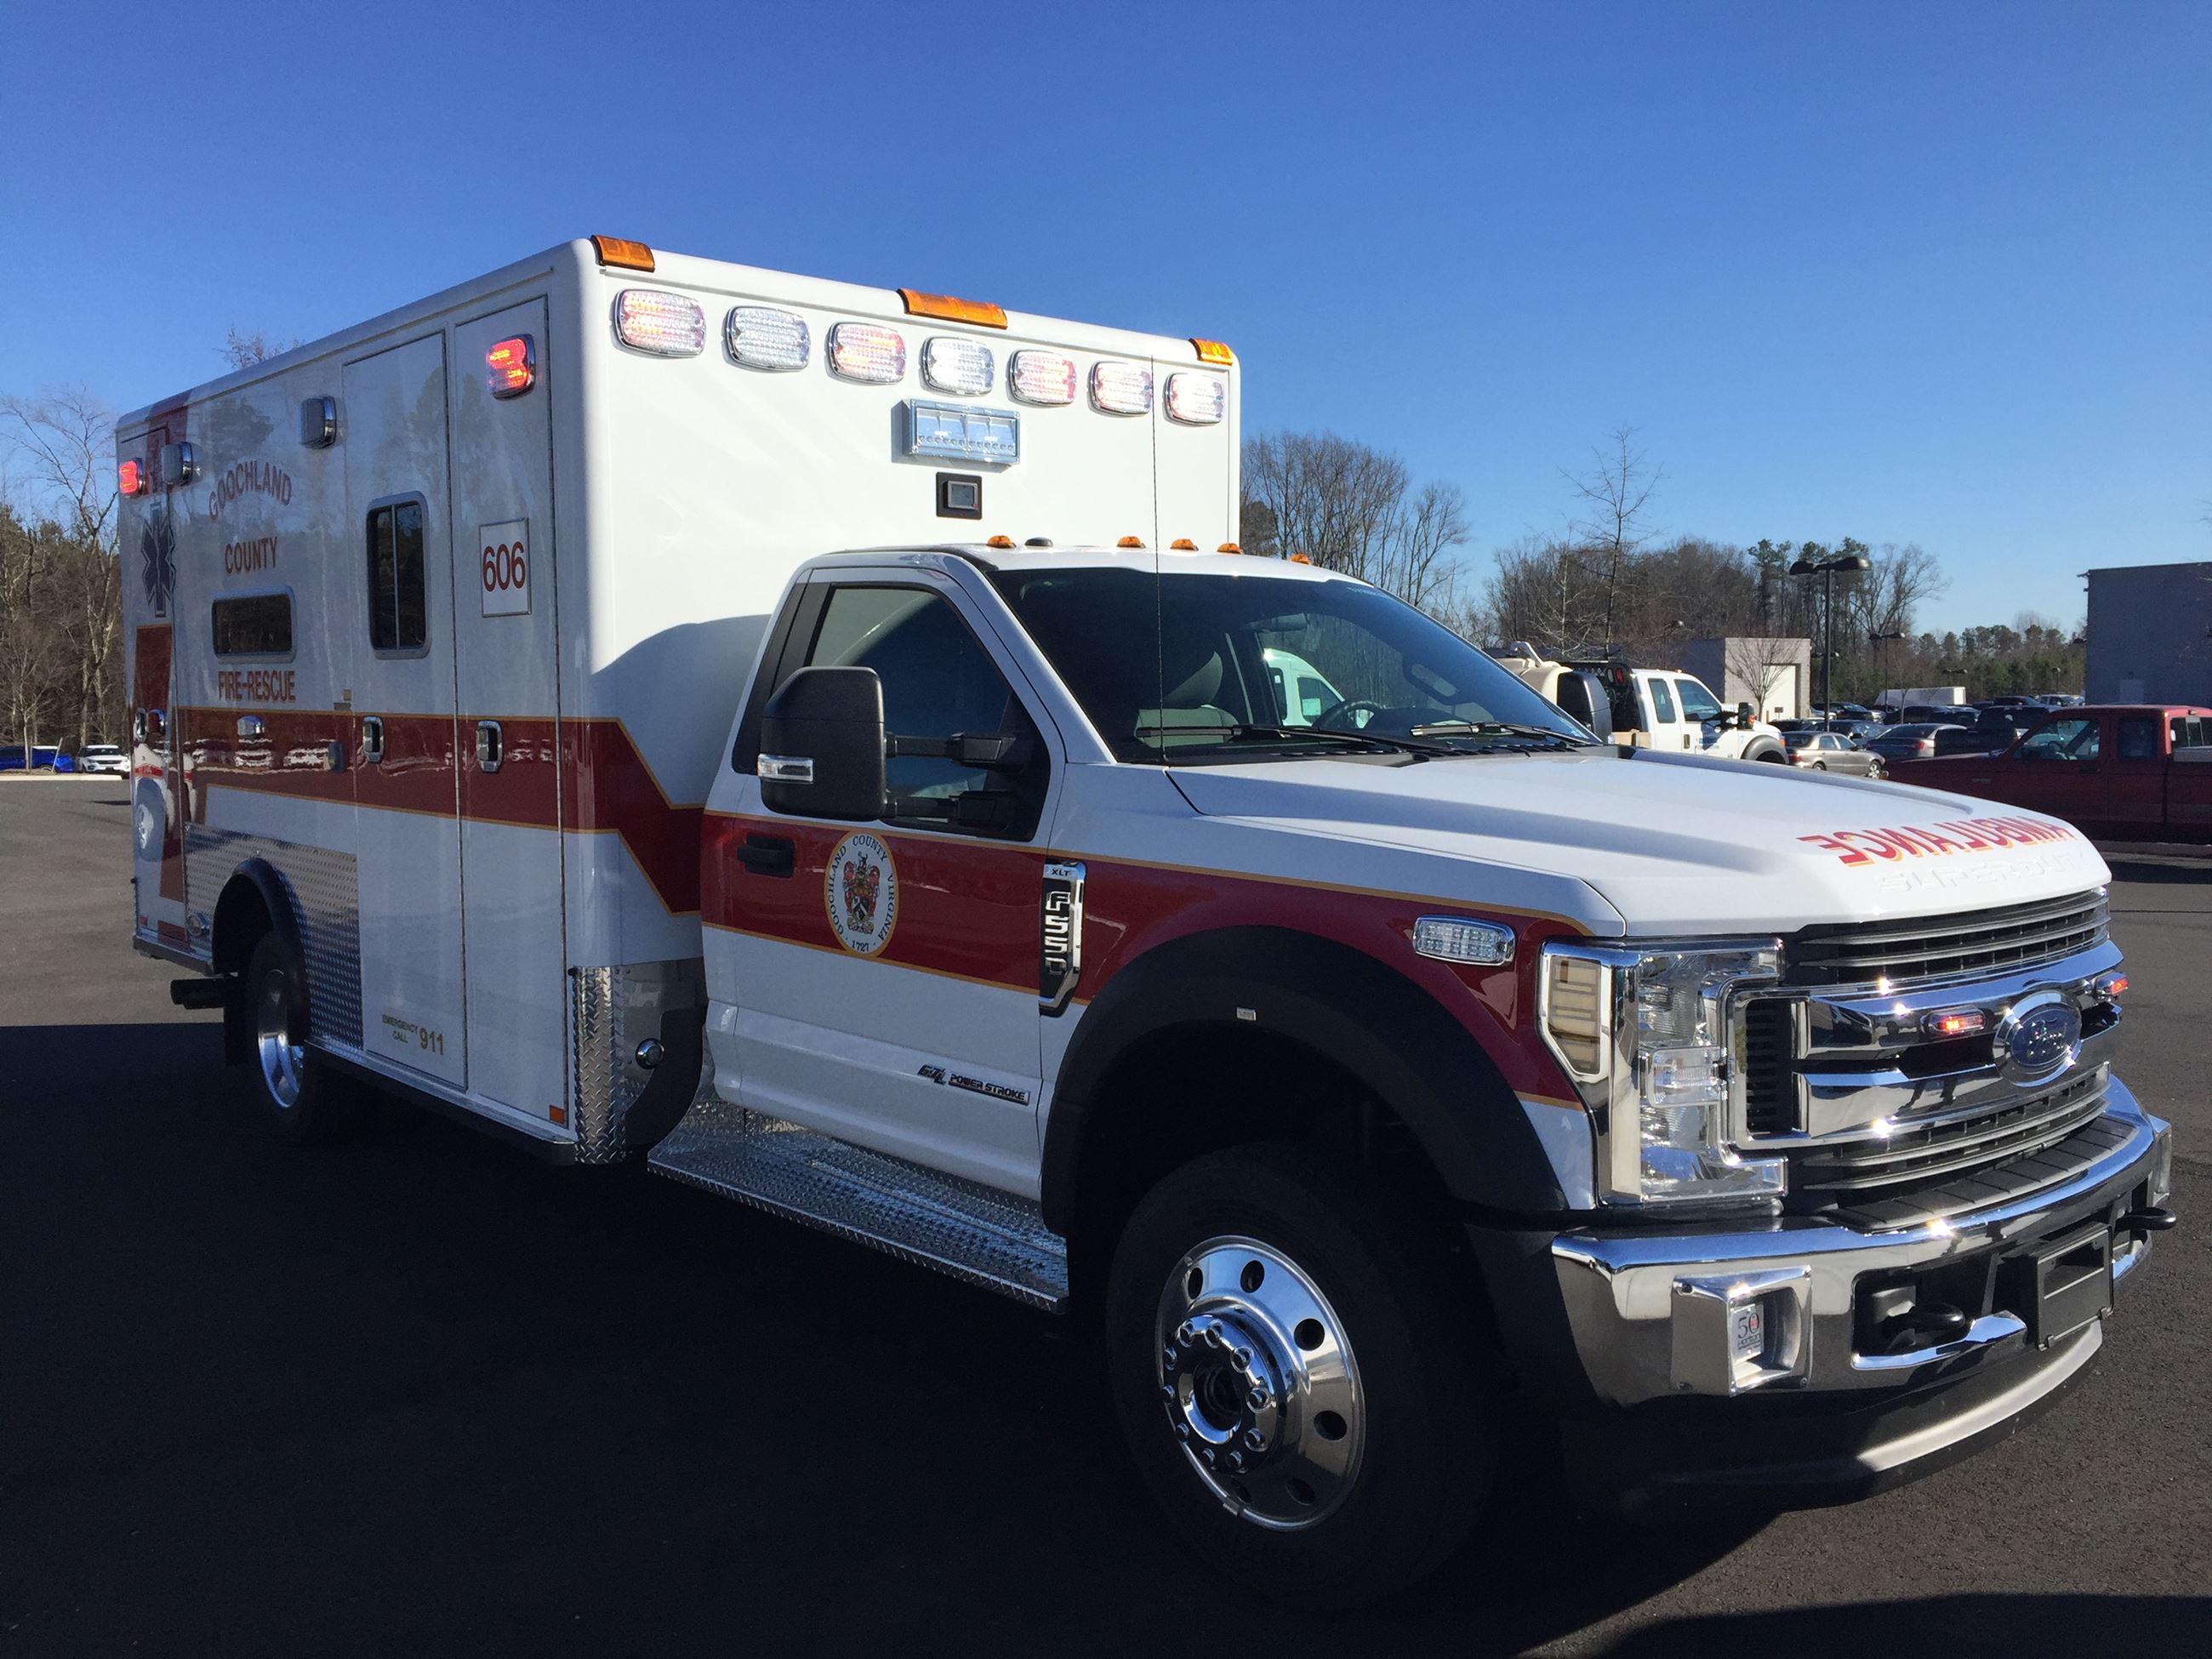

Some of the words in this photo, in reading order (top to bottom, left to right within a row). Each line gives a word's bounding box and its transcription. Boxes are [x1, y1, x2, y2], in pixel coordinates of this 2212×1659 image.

[209, 460, 292, 521] GOOCHLAND
[225, 536, 277, 573] COUNTY
[482, 541, 526, 592] 606
[218, 670, 296, 701] FIRE-RESCUE
[1051, 868, 1070, 877] XLT
[1878, 862, 2021, 892] SUPER
[828, 845, 847, 935] GOOCHLAND
[852, 835, 888, 862] COUNTY
[877, 873, 895, 941] VIRGINIA
[852, 939, 869, 952] 1727
[392, 1030, 408, 1044] CALL
[419, 1027, 444, 1056] 911
[950, 1073, 983, 1090] POWER
[985, 1082, 1026, 1101] STROKE
[1738, 1313, 1760, 1338] 50
